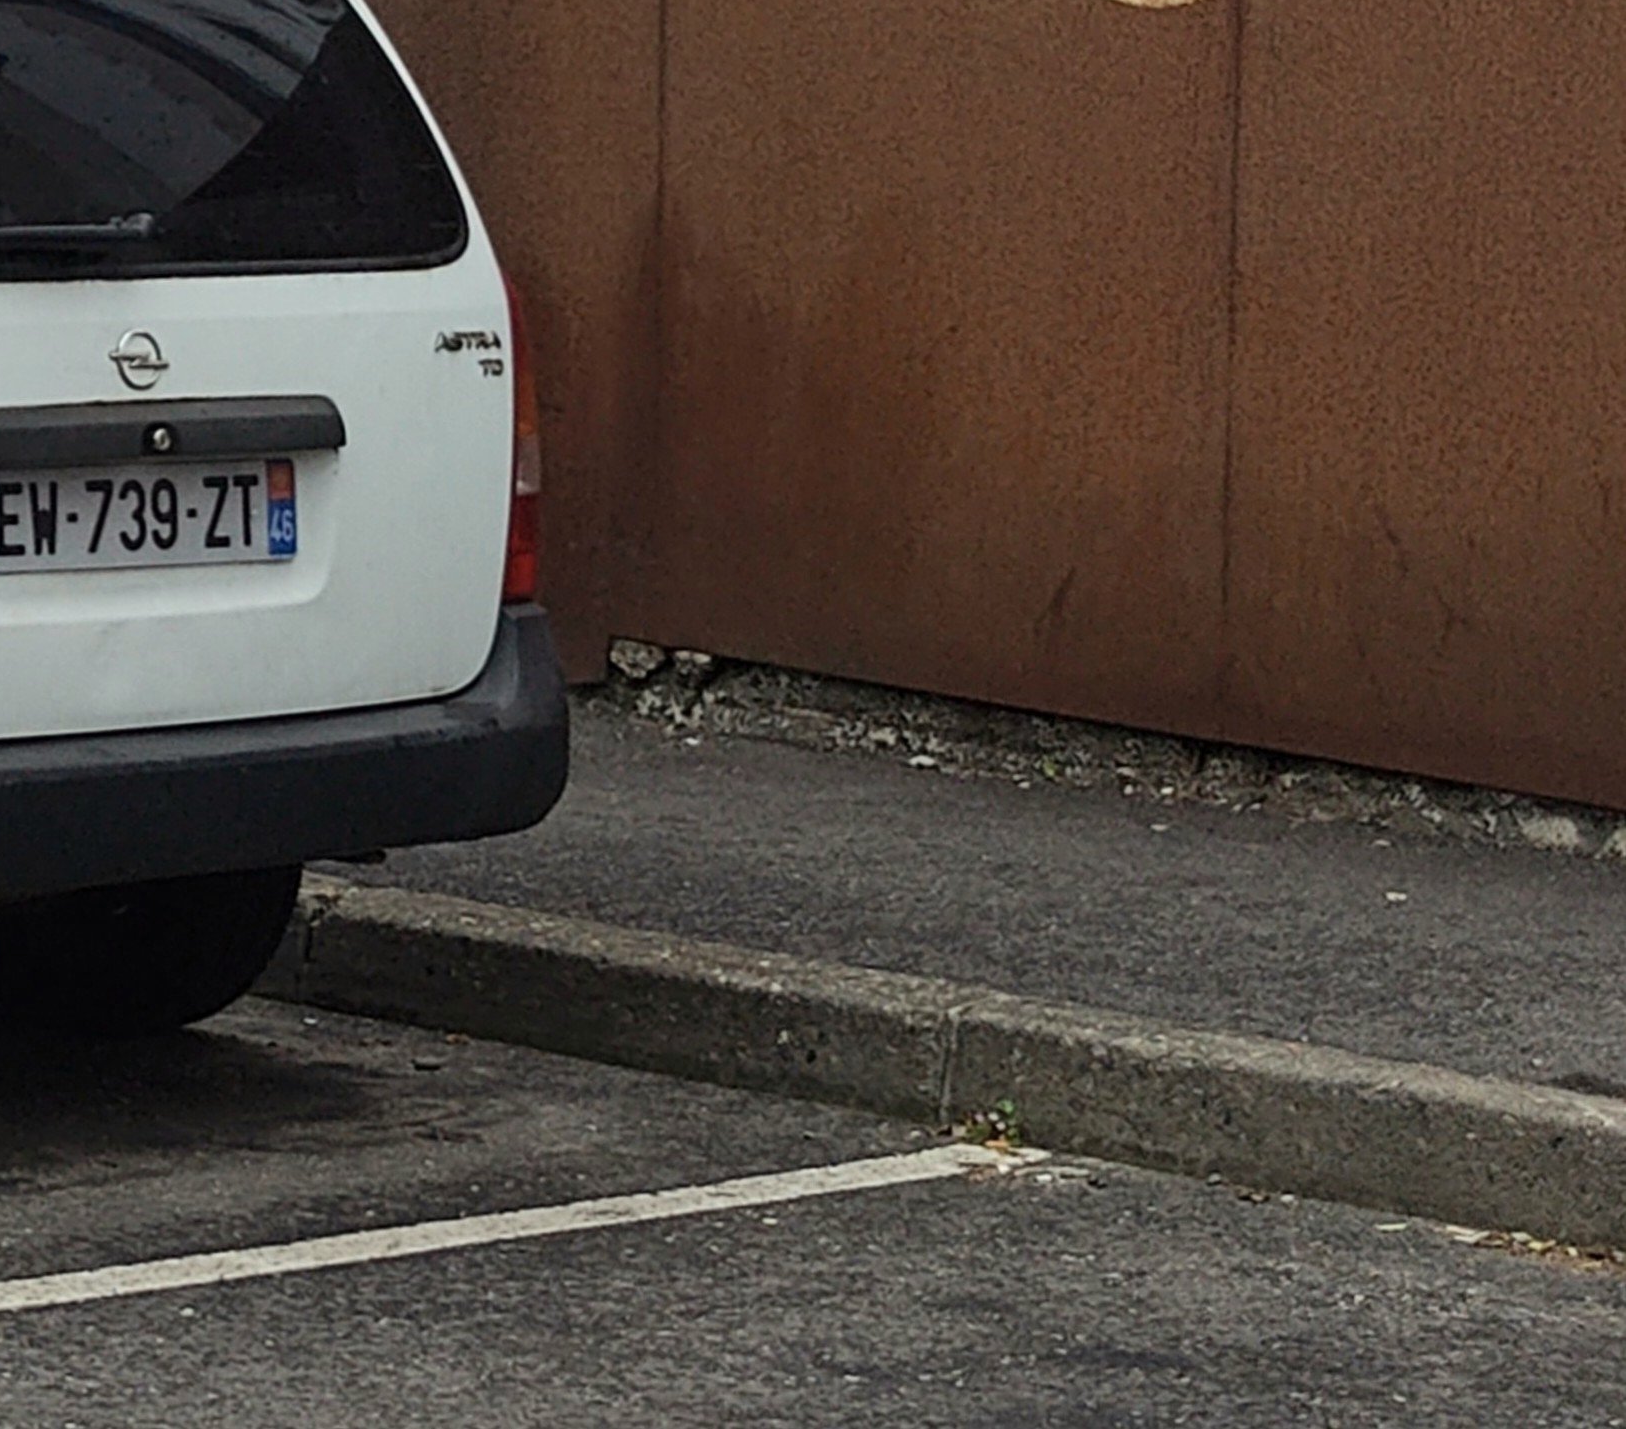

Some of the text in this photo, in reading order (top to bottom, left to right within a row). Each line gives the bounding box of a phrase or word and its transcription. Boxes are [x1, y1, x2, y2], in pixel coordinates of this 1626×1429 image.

[434, 330, 501, 353] ASTRA
[477, 358, 504, 378] TD
[270, 509, 294, 543] 46
